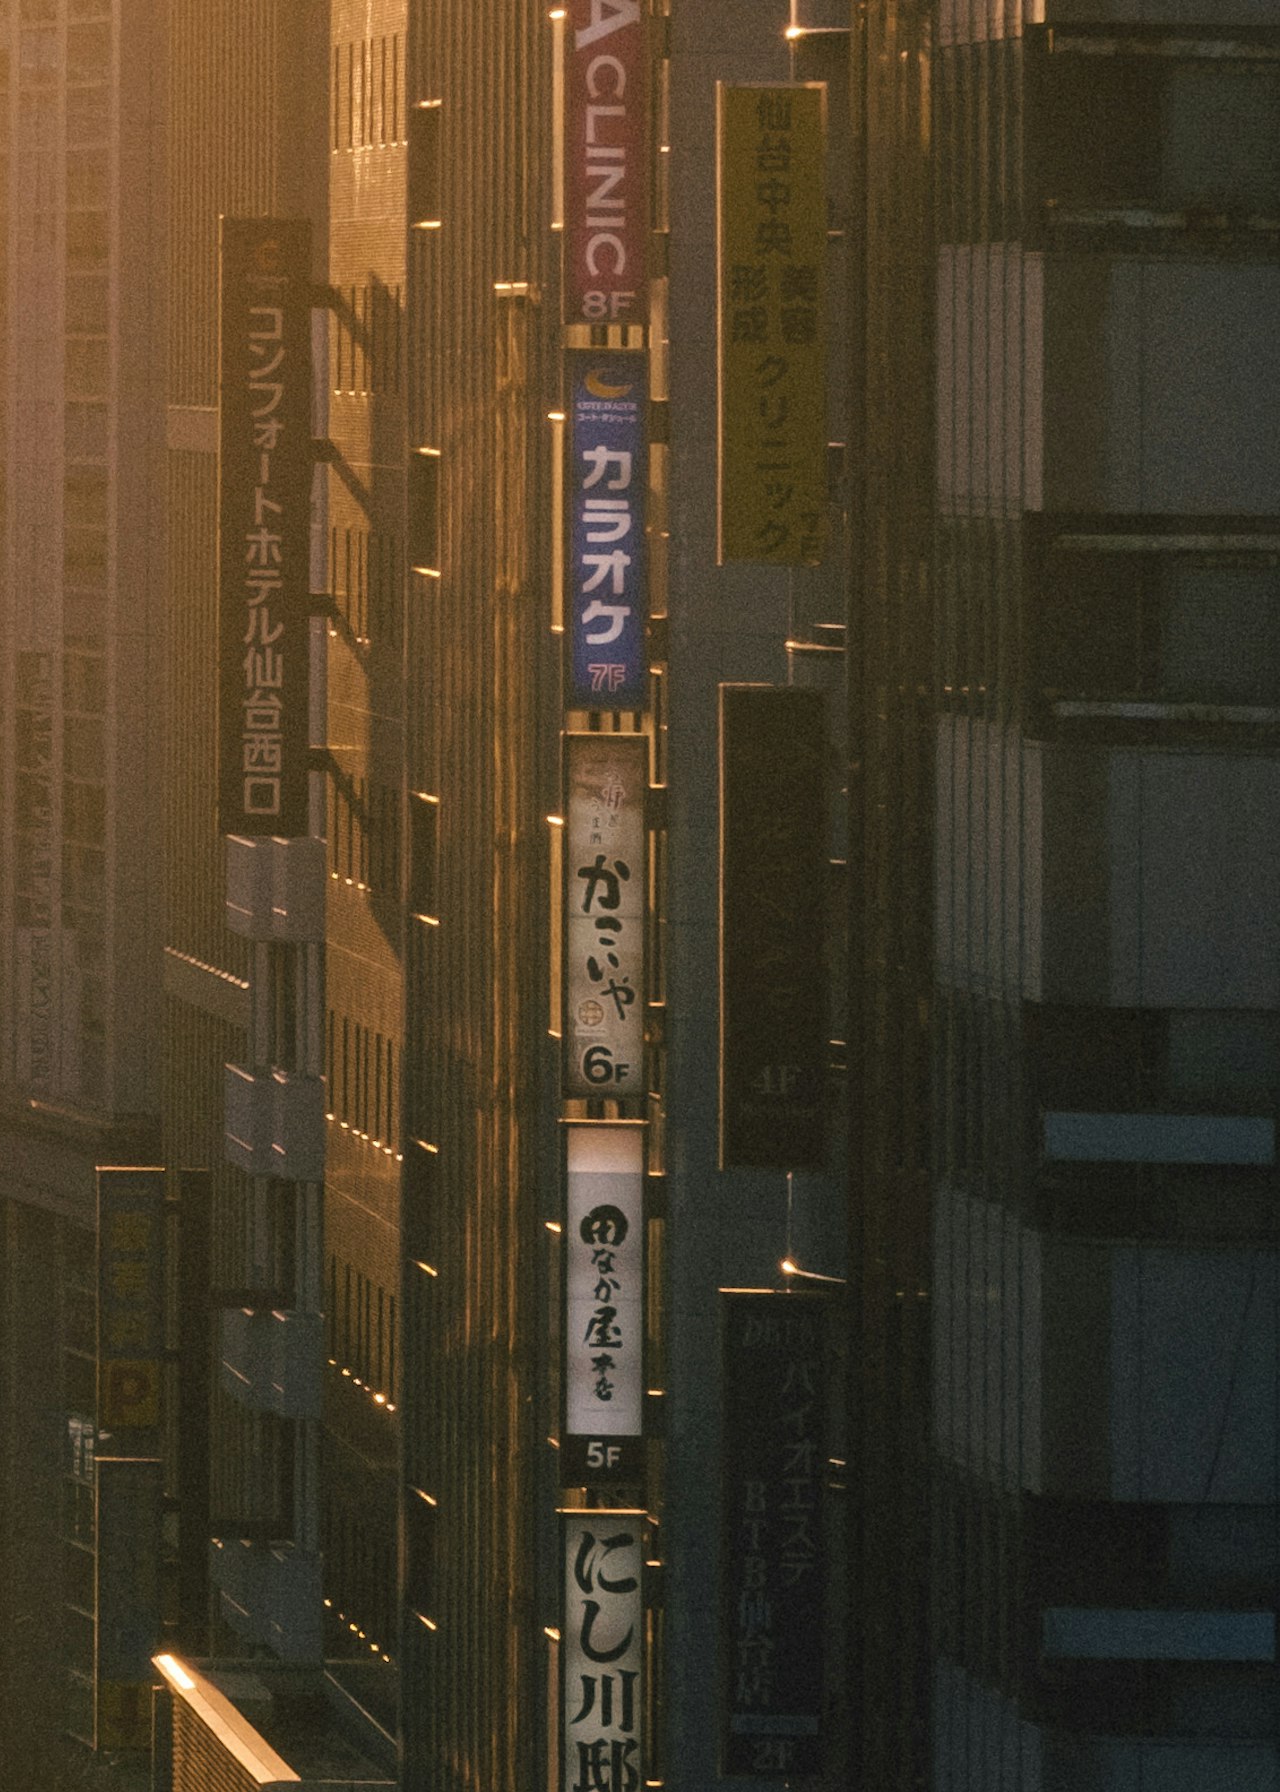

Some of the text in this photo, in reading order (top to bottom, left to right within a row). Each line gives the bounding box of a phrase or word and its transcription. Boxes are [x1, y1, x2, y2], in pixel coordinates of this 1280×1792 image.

[585, 55, 627, 276] CLINIC
[581, 290, 637, 319] 8F
[581, 444, 633, 646] カラオケ
[754, 354, 793, 554] クリニック
[242, 306, 286, 817] コンフォートホテル仙台西口
[587, 664, 627, 693] 7F
[583, 1045, 630, 1085] 6F
[587, 1441, 621, 1469] 5F
[778, 1359, 817, 1585] バイオエステ
